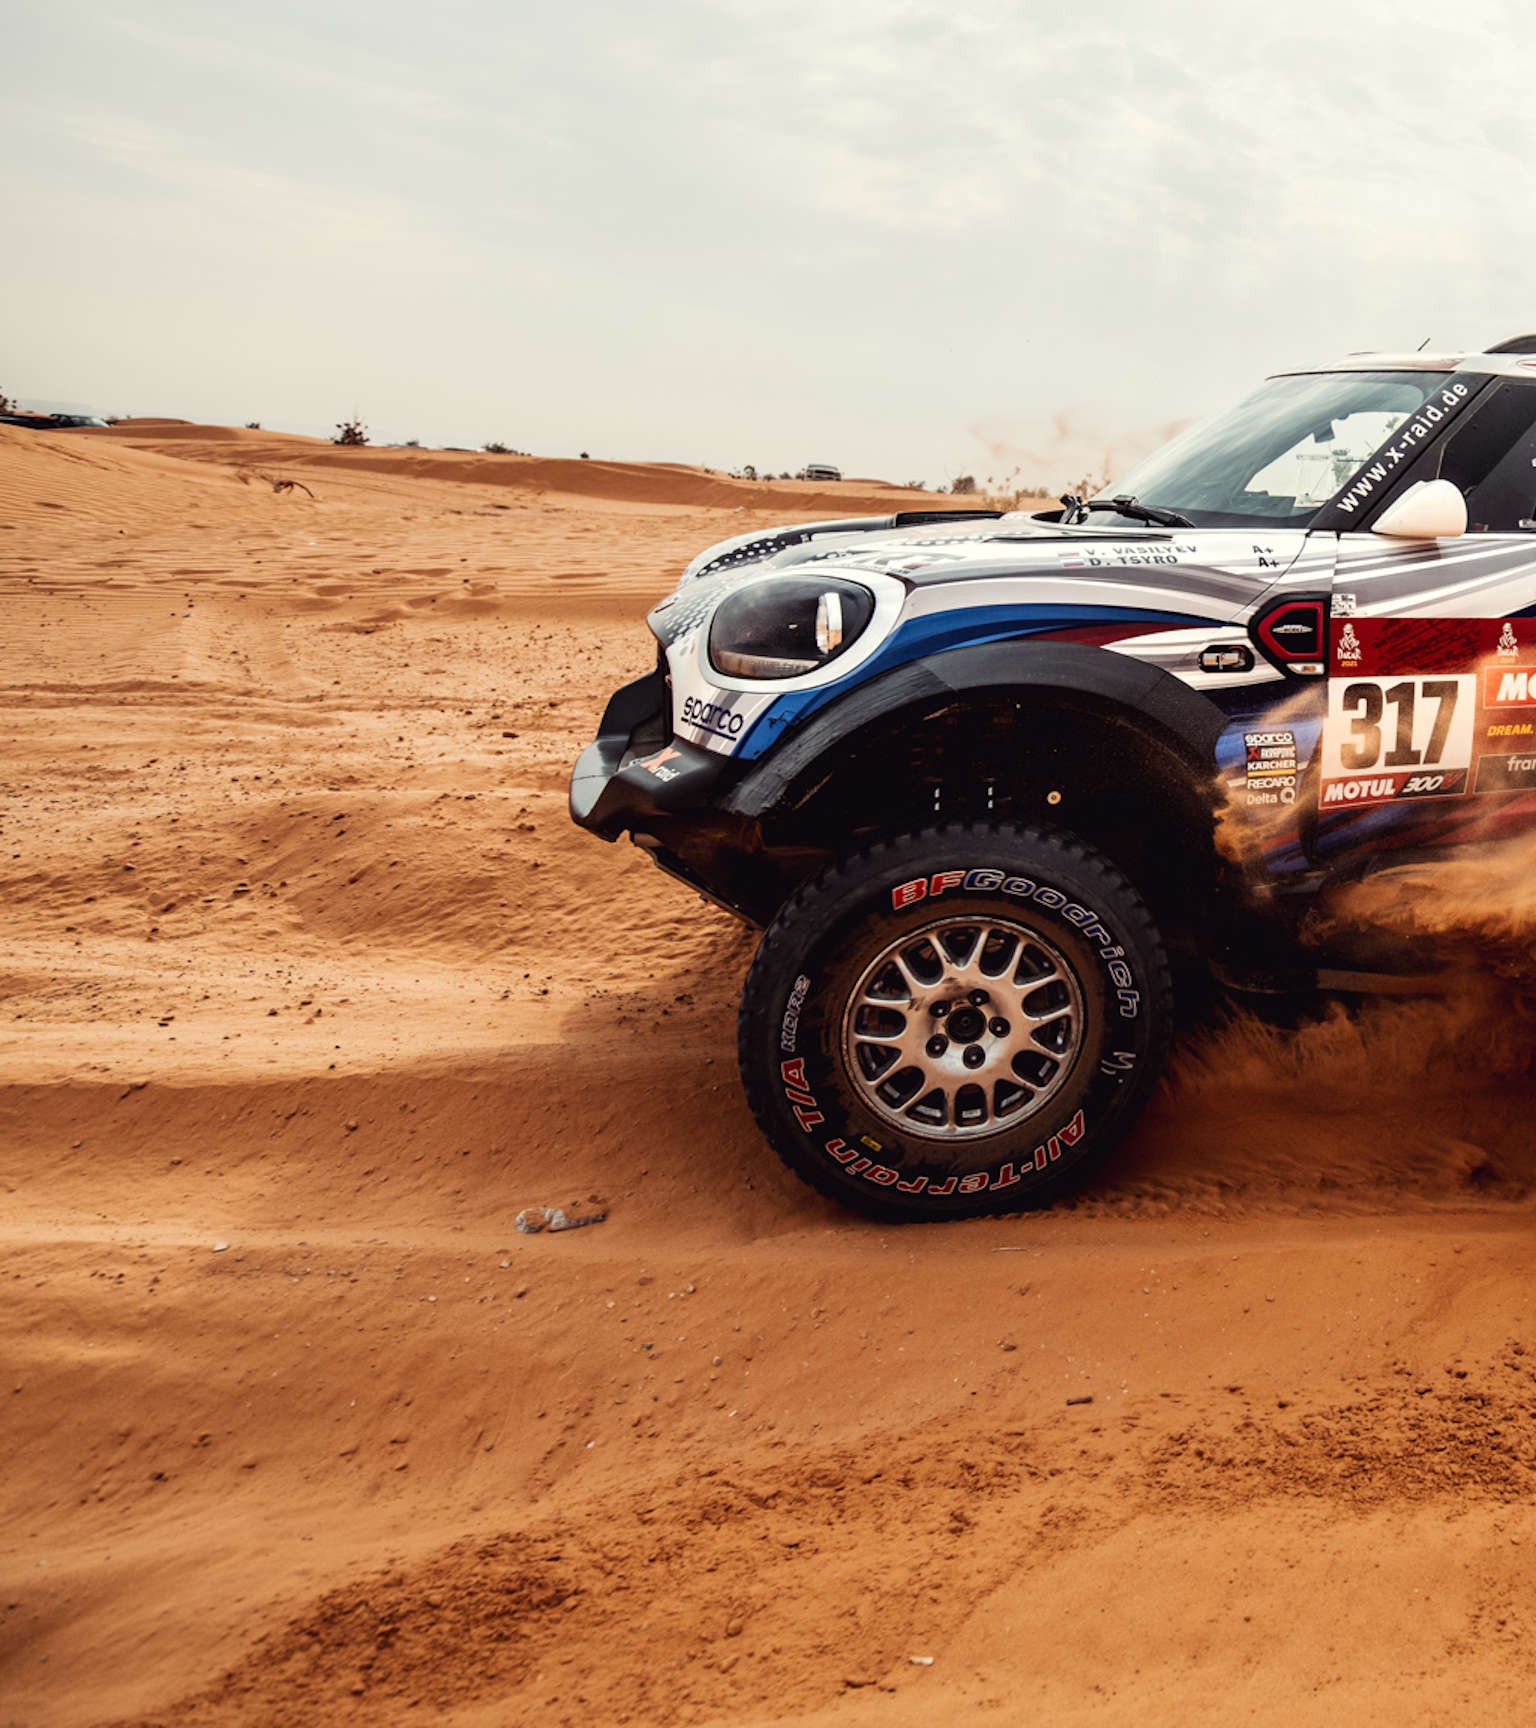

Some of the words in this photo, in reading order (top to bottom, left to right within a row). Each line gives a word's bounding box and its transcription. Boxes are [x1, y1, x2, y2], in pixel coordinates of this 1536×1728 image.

[1336, 383, 1468, 512] www.x-raid.de
[1089, 557, 1111, 567] D.
[1119, 555, 1178, 565] TSYRO
[1258, 557, 1280, 568] A+
[683, 696, 744, 734] sparco
[1340, 680, 1459, 770] 317
[1487, 724, 1533, 737] DREAM.
[1247, 776, 1297, 790] RECARO
[1323, 779, 1396, 801] MOTUL
[1247, 792, 1279, 805] Delta
[891, 869, 1141, 1019] BFGoodrich
[824, 1109, 1087, 1195] All-Terrain
